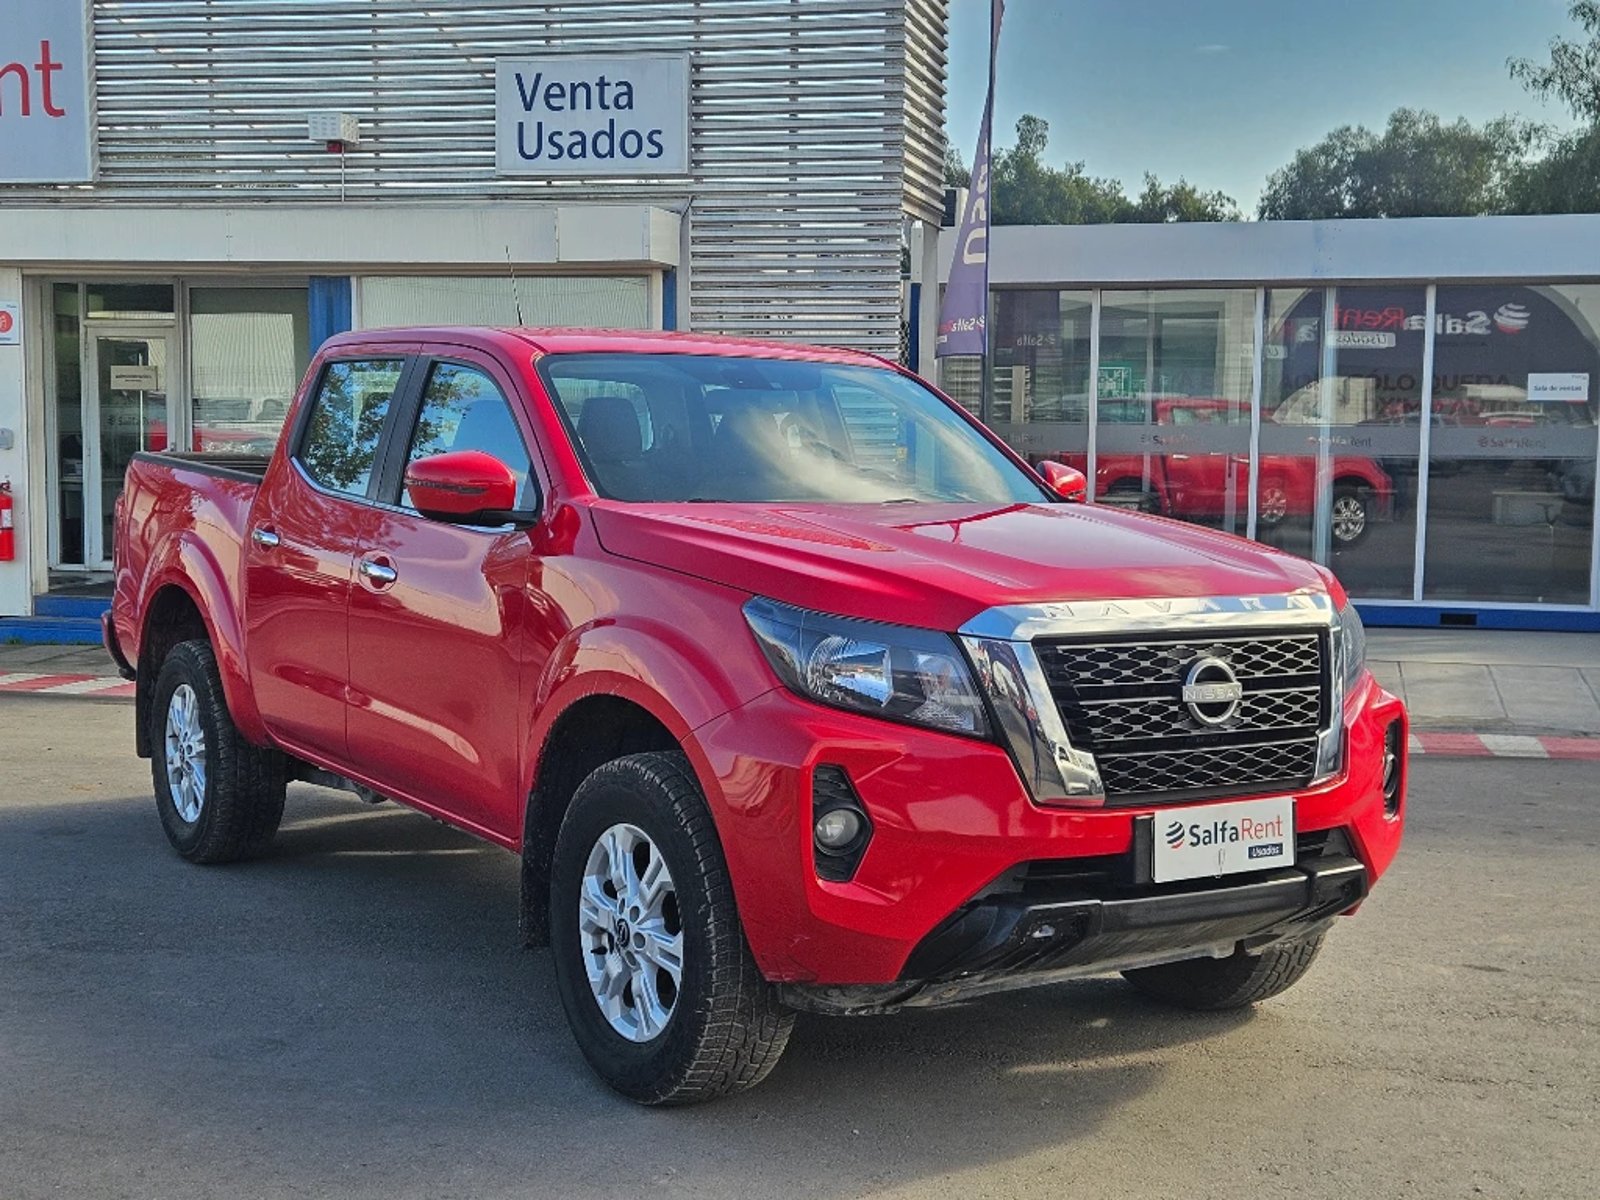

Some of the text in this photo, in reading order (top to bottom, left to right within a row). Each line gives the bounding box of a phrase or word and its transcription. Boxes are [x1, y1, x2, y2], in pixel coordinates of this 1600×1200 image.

[515, 72, 634, 112] Venta
[517, 118, 664, 160] Usados
[1044, 595, 1310, 618] NAVARA
[1184, 687, 1242, 702] NISSAN
[1188, 814, 1284, 848] SalfaRent
[1251, 844, 1281, 857] Usados
